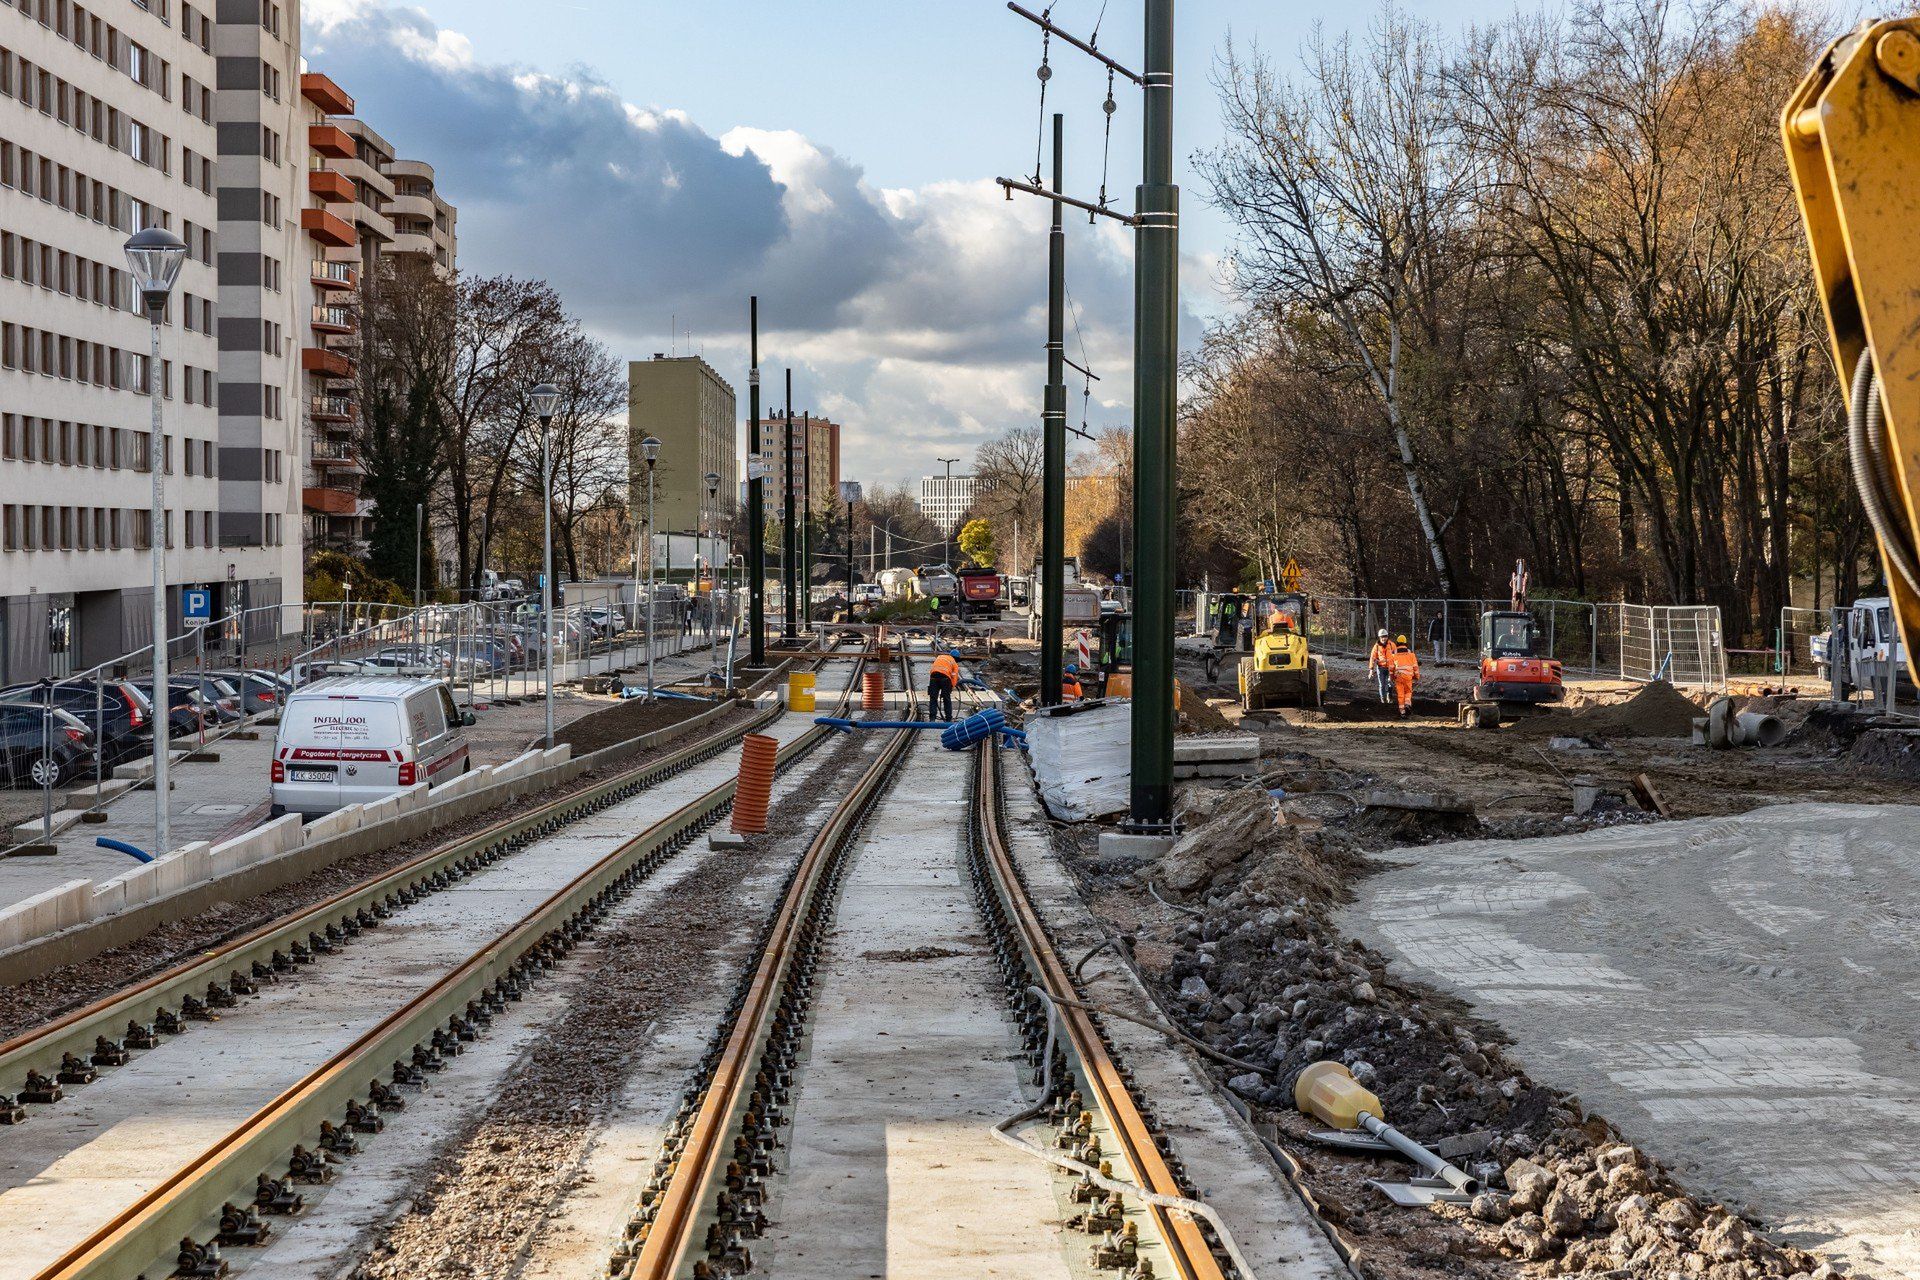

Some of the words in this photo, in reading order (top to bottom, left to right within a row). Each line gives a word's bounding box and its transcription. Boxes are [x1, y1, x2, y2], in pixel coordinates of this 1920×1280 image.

[190, 594, 204, 613] P
[301, 750, 335, 758] Pogotowie
[337, 750, 382, 759] Energetyczne
